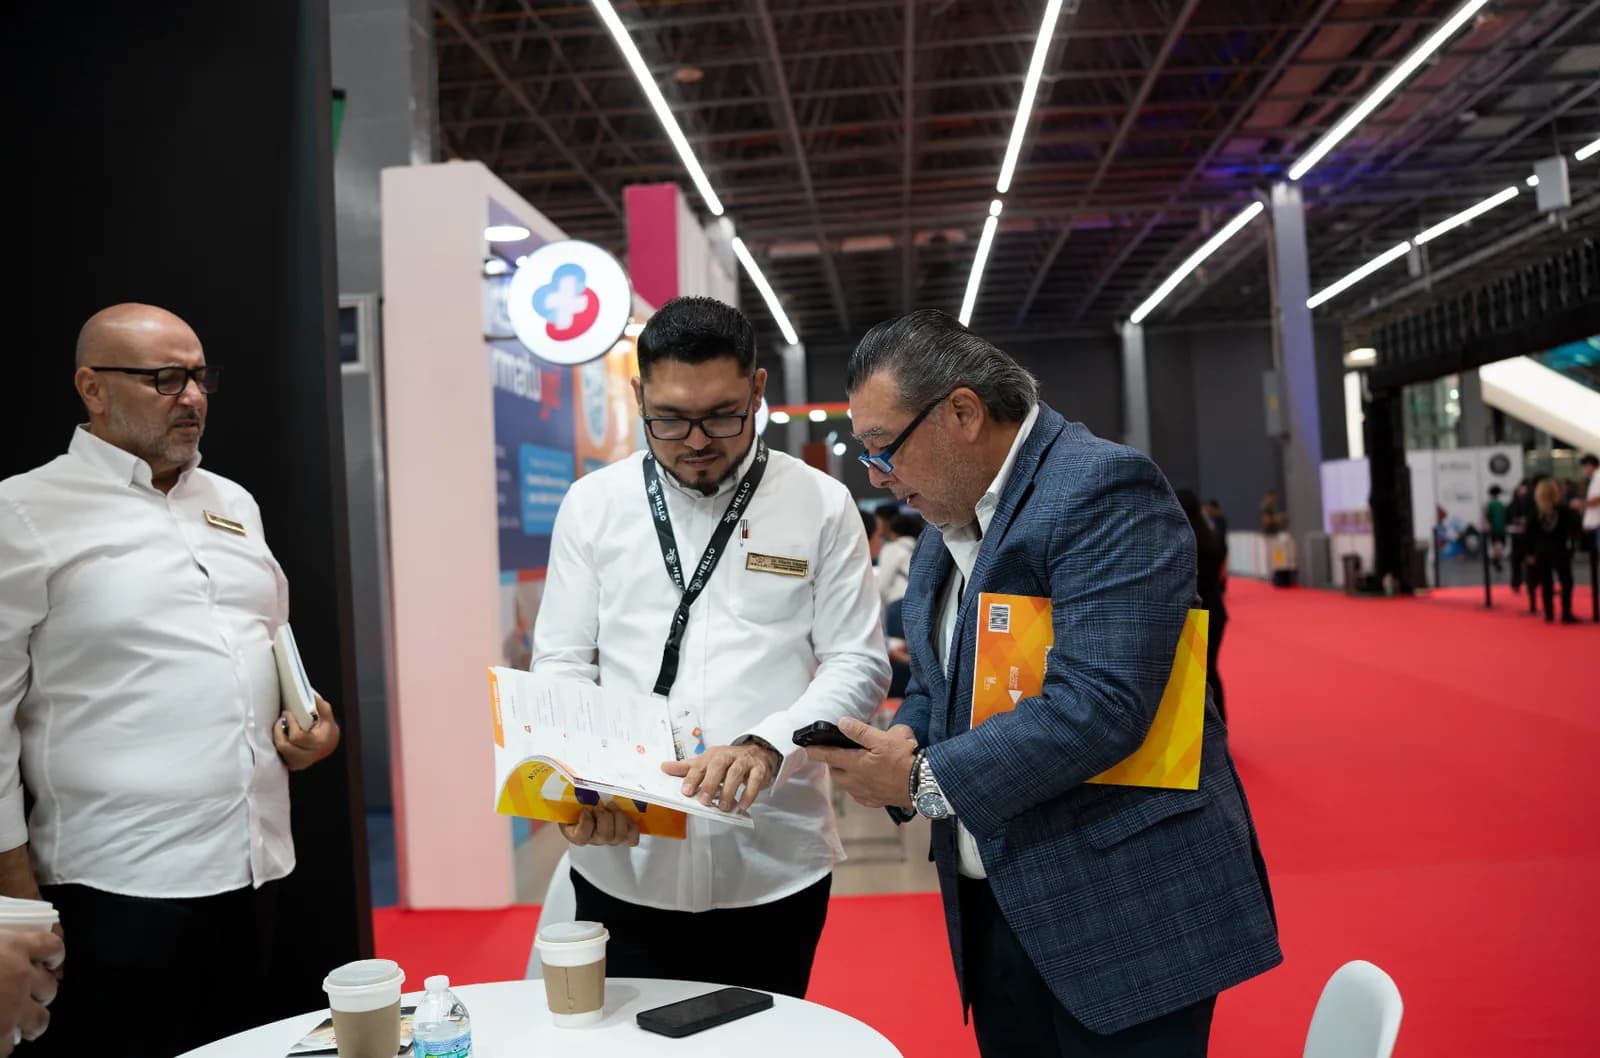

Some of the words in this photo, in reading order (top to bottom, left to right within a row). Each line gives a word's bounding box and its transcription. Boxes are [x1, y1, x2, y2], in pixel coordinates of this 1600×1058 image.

[655, 494, 667, 521] HELLO
[733, 482, 750, 508] HELLO
[698, 548, 715, 576] HELLO
